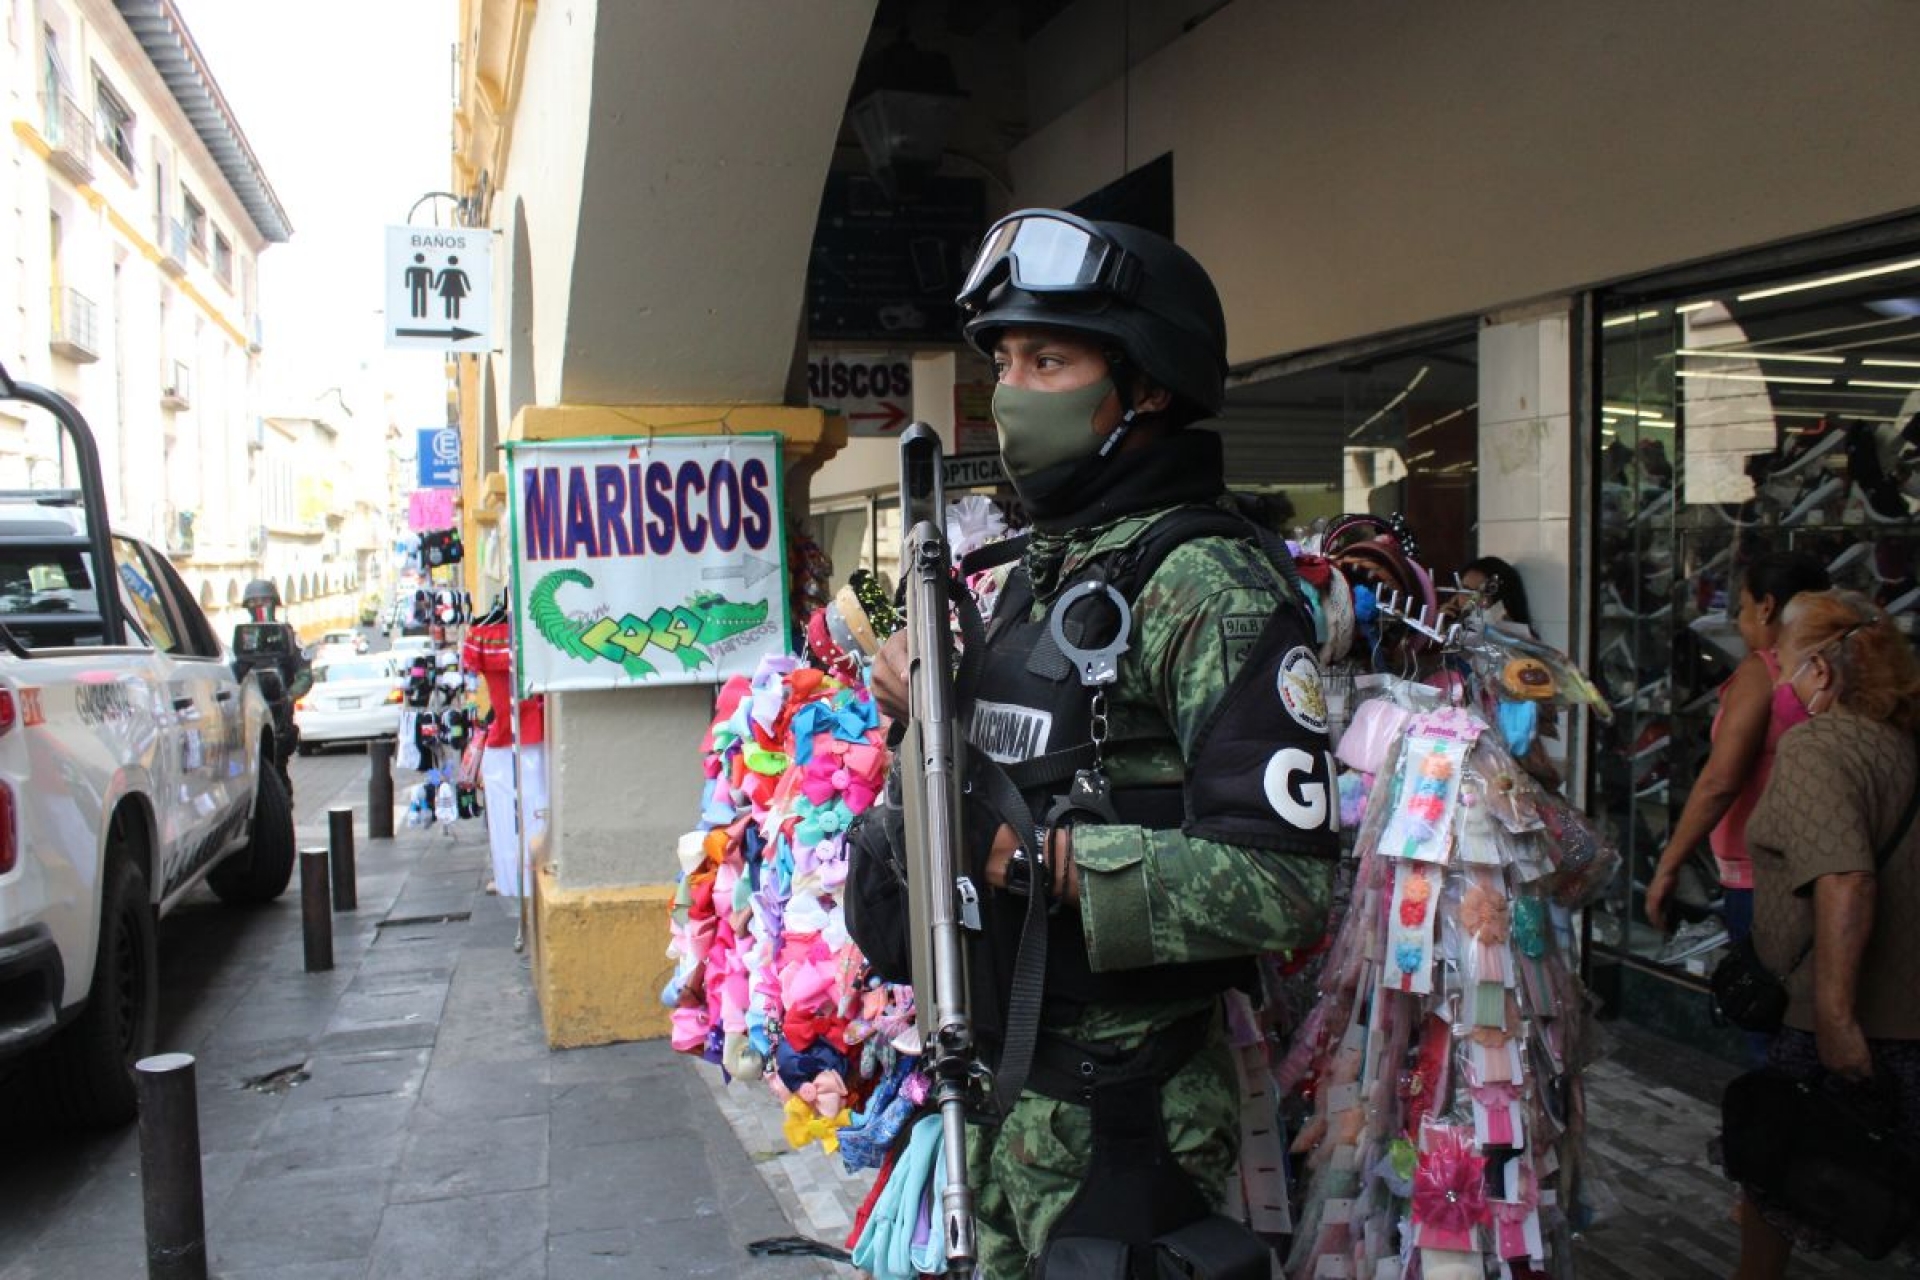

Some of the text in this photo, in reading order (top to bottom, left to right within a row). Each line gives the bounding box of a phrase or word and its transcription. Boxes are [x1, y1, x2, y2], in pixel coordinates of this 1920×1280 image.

[411, 233, 467, 249] BAÑOS
[707, 620, 779, 661] Mariscos
[1264, 747, 1339, 832] G
